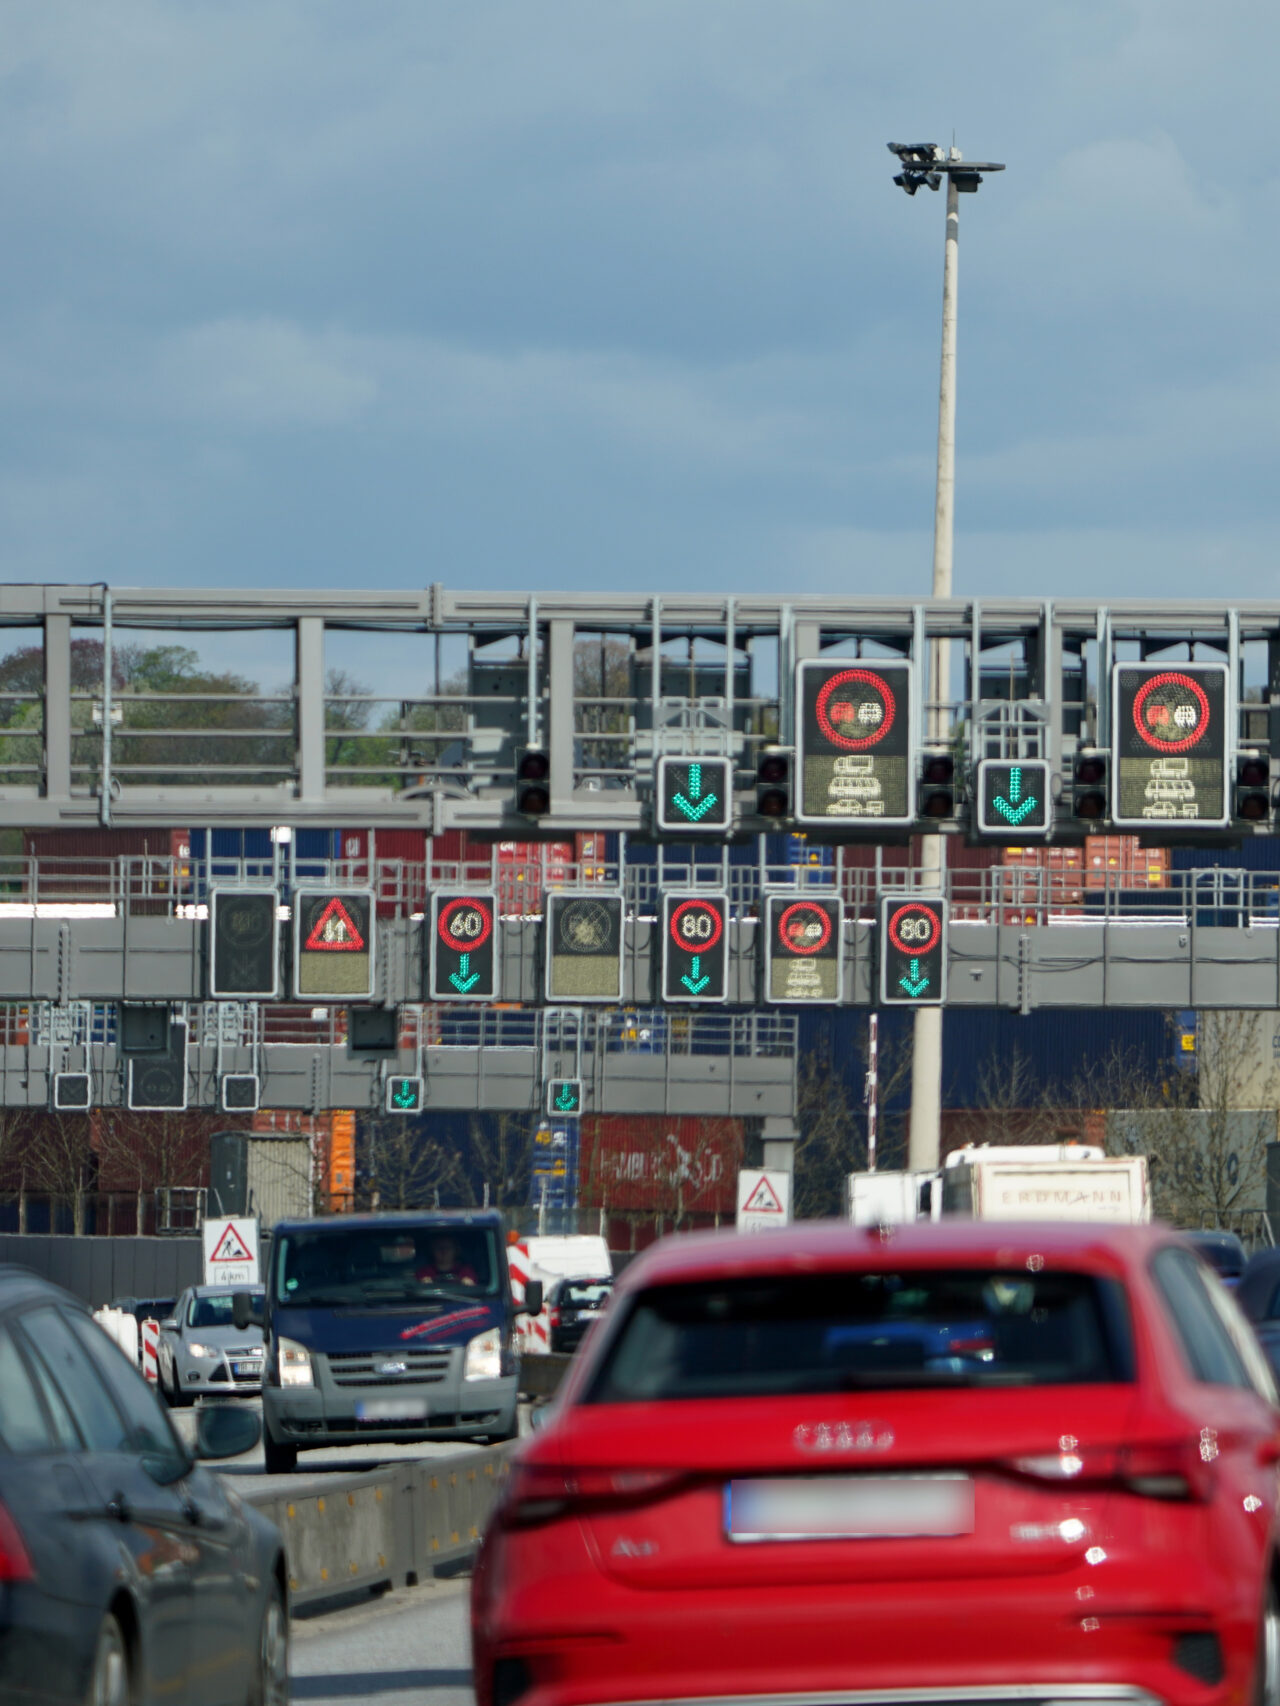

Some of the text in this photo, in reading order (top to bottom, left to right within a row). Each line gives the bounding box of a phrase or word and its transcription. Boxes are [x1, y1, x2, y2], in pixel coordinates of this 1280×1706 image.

[449, 911, 482, 937] 60
[680, 913, 711, 938] 80
[899, 916, 931, 941] 80
